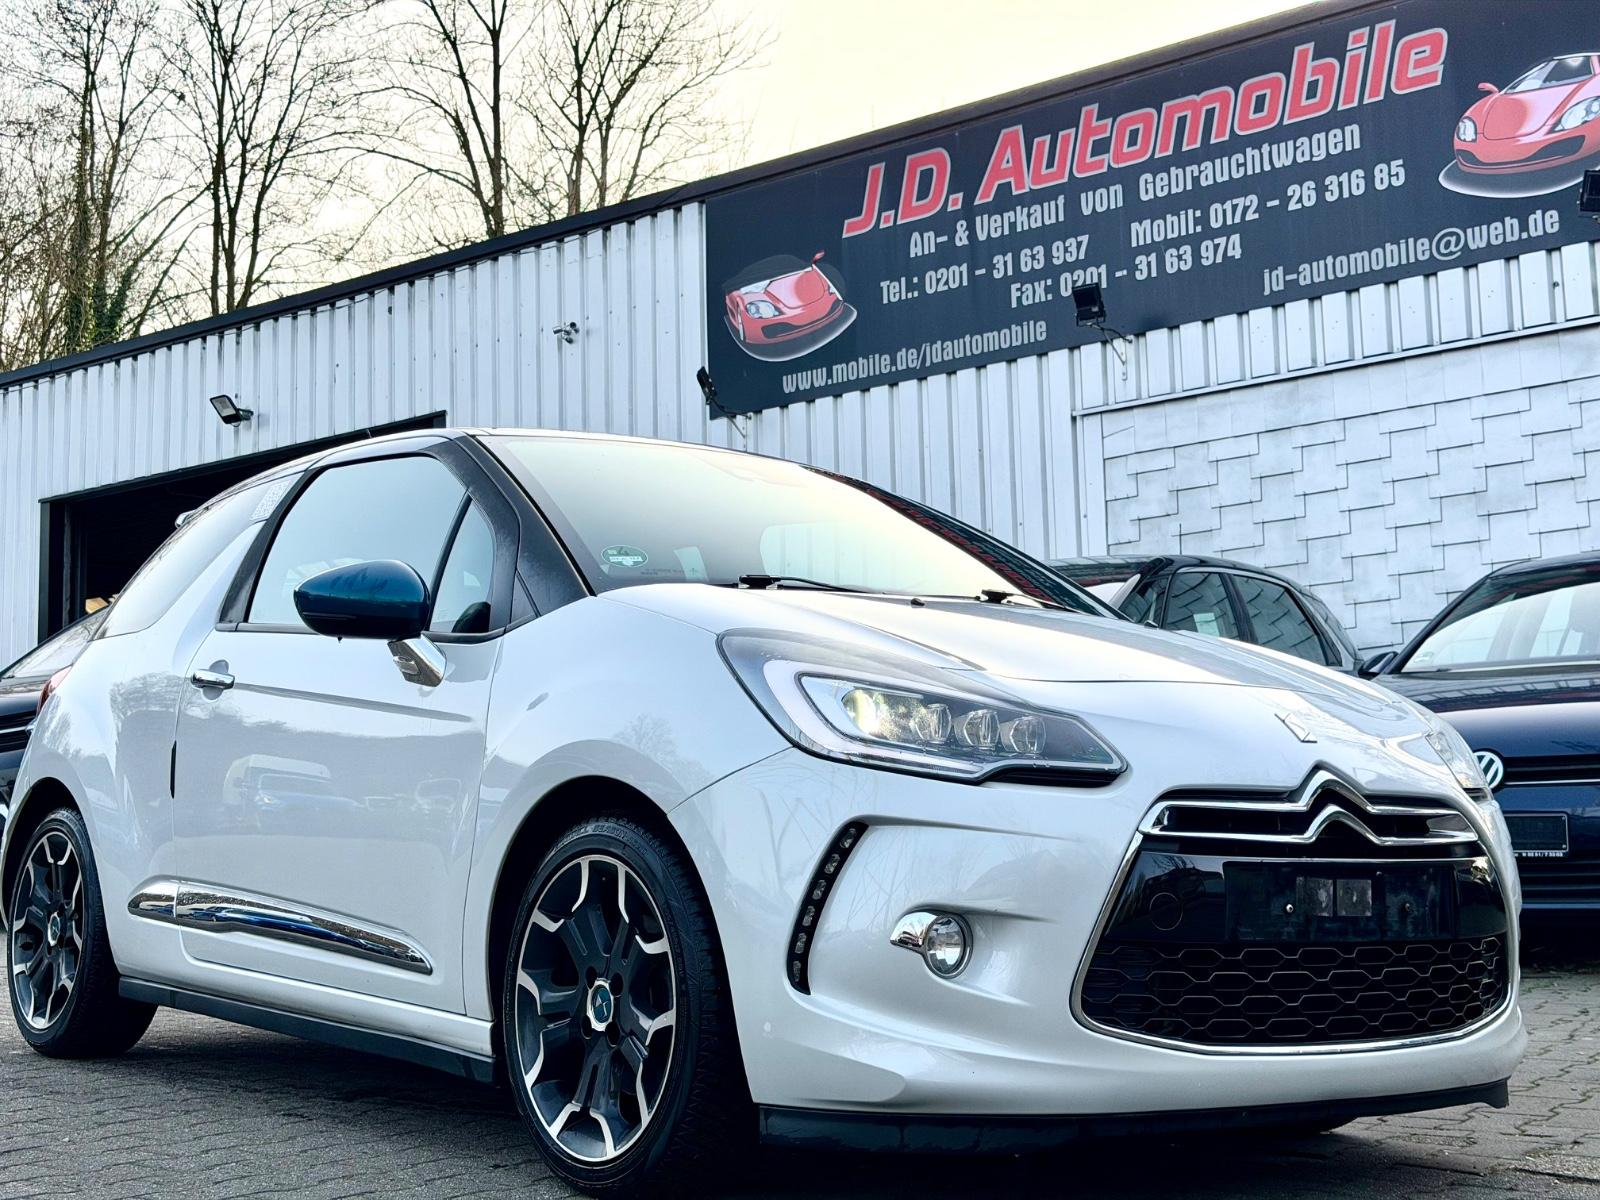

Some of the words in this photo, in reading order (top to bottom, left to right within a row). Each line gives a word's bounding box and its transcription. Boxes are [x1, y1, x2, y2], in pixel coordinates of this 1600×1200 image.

[842, 147, 964, 238] J.D.
[973, 19, 1447, 206] Automobile
[909, 230, 948, 258] An-
[954, 219, 970, 247] &
[975, 194, 1065, 242] Verkauf
[1080, 183, 1124, 216] von
[1138, 123, 1361, 202] Gebrauchtwagen
[1130, 208, 1202, 248] Mobil:
[1209, 194, 1260, 229] 0172
[1287, 180, 1317, 212] 26
[1324, 169, 1366, 202] 316
[1373, 158, 1406, 191] 85
[879, 276, 919, 304] Tel.:
[924, 262, 968, 295] 0201
[992, 252, 1013, 279] 31
[1019, 245, 1045, 273] 63
[1051, 234, 1090, 266] 937
[1010, 278, 1053, 309] Fax:
[1135, 252, 1158, 281] 31
[1165, 244, 1193, 274] 63
[1200, 233, 1242, 267] 974
[1263, 208, 1560, 296] jd-automobile@web.de
[782, 320, 1047, 394] www.mobile.de/jdautomobile
